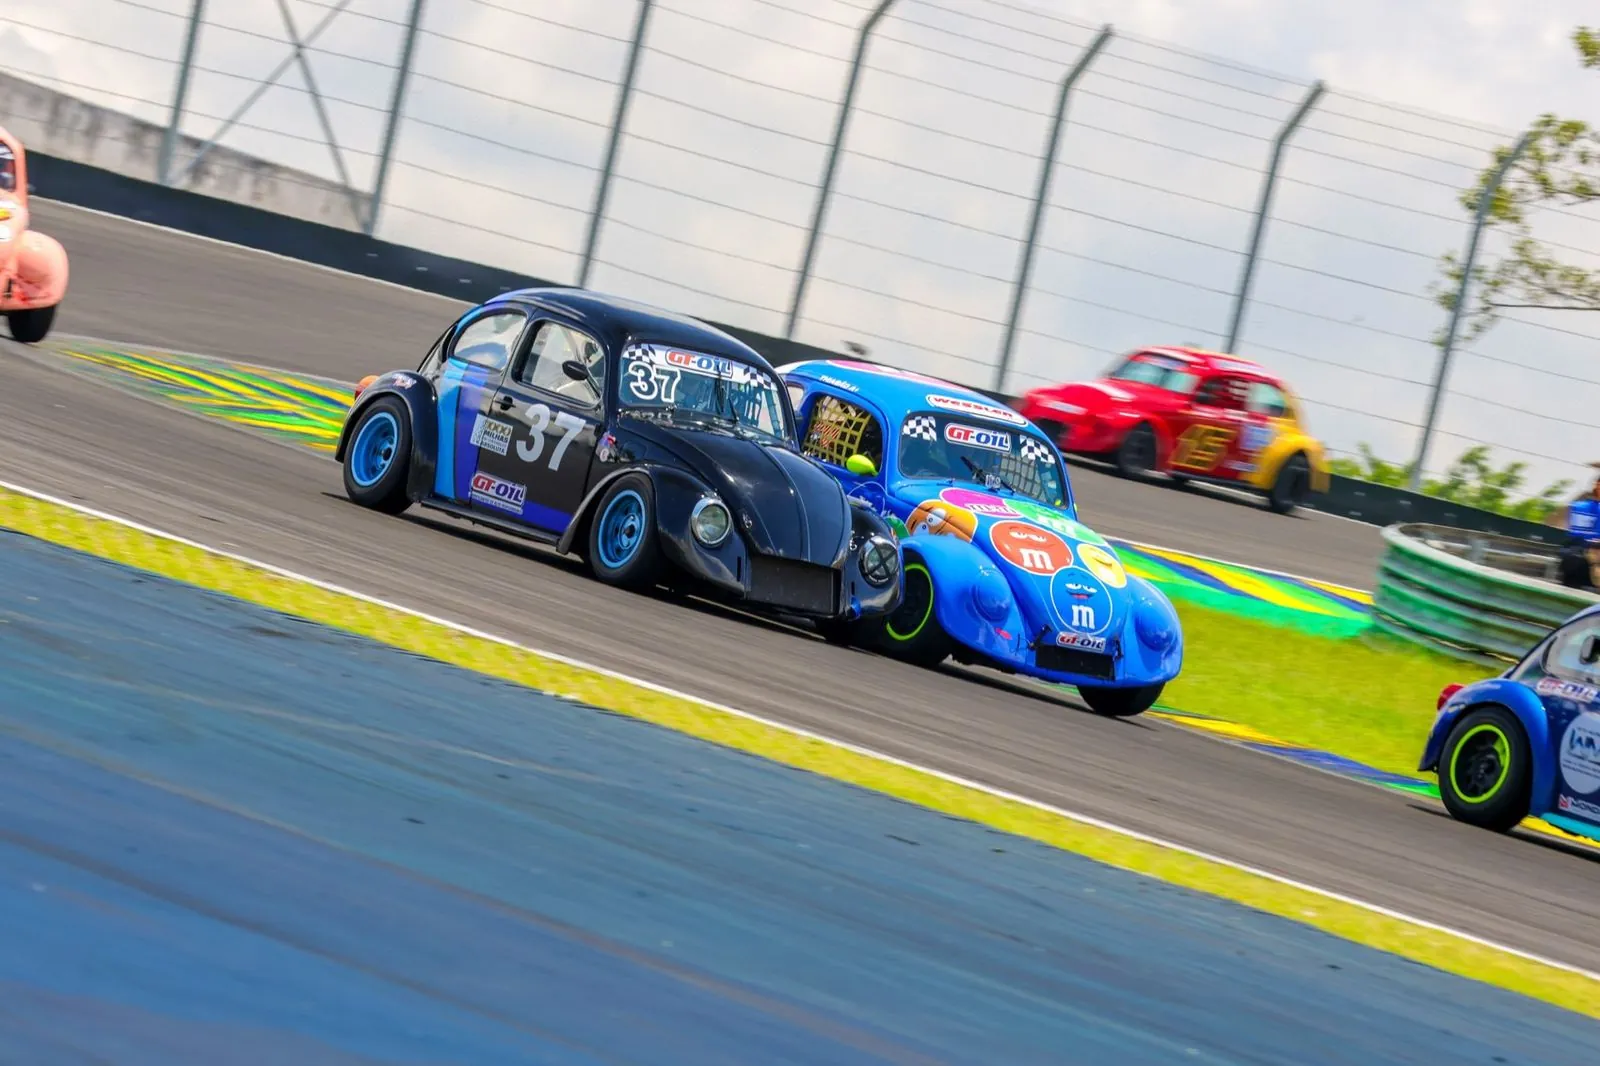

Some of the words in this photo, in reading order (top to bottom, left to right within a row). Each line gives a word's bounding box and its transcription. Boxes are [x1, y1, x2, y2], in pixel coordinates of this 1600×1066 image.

[628, 361, 681, 403] 37
[516, 403, 586, 471] 37
[1019, 548, 1055, 571] m
[1072, 604, 1096, 629] m
